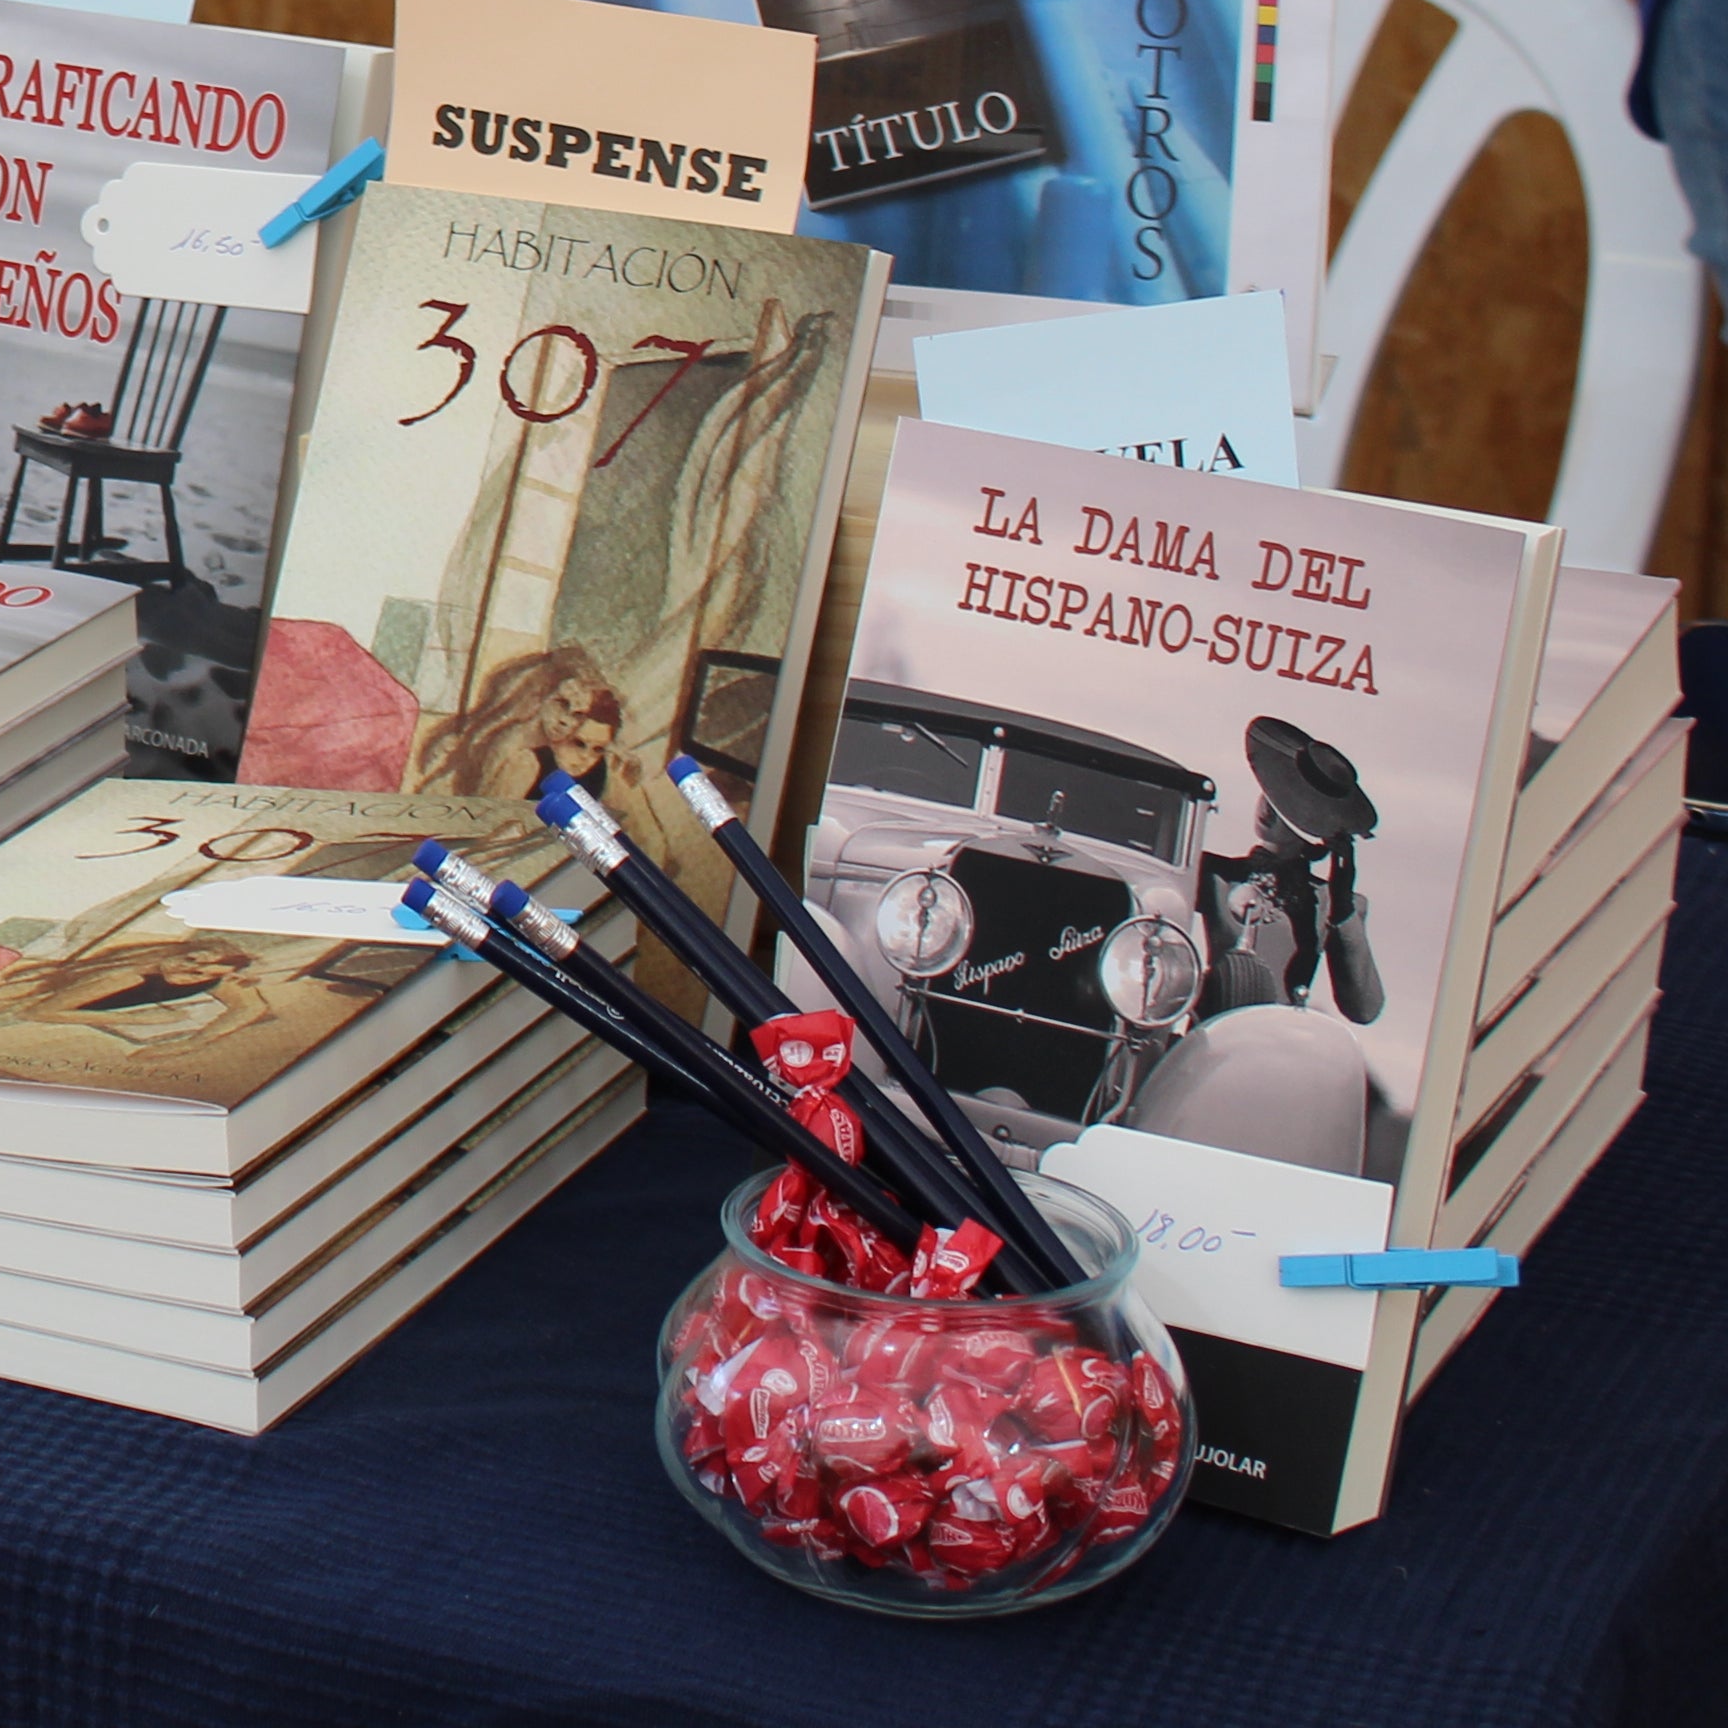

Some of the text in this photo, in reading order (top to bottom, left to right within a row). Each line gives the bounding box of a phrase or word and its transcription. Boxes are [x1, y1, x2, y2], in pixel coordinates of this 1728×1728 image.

[432, 102, 769, 205] SUSPENSE
[813, 89, 1020, 175] TÍTULO
[443, 221, 743, 300] HABITACIÓN
[398, 298, 715, 469] 307
[972, 485, 1372, 611] LA DAMA DEL
[957, 560, 1380, 696] HISPANO-SUIZA
